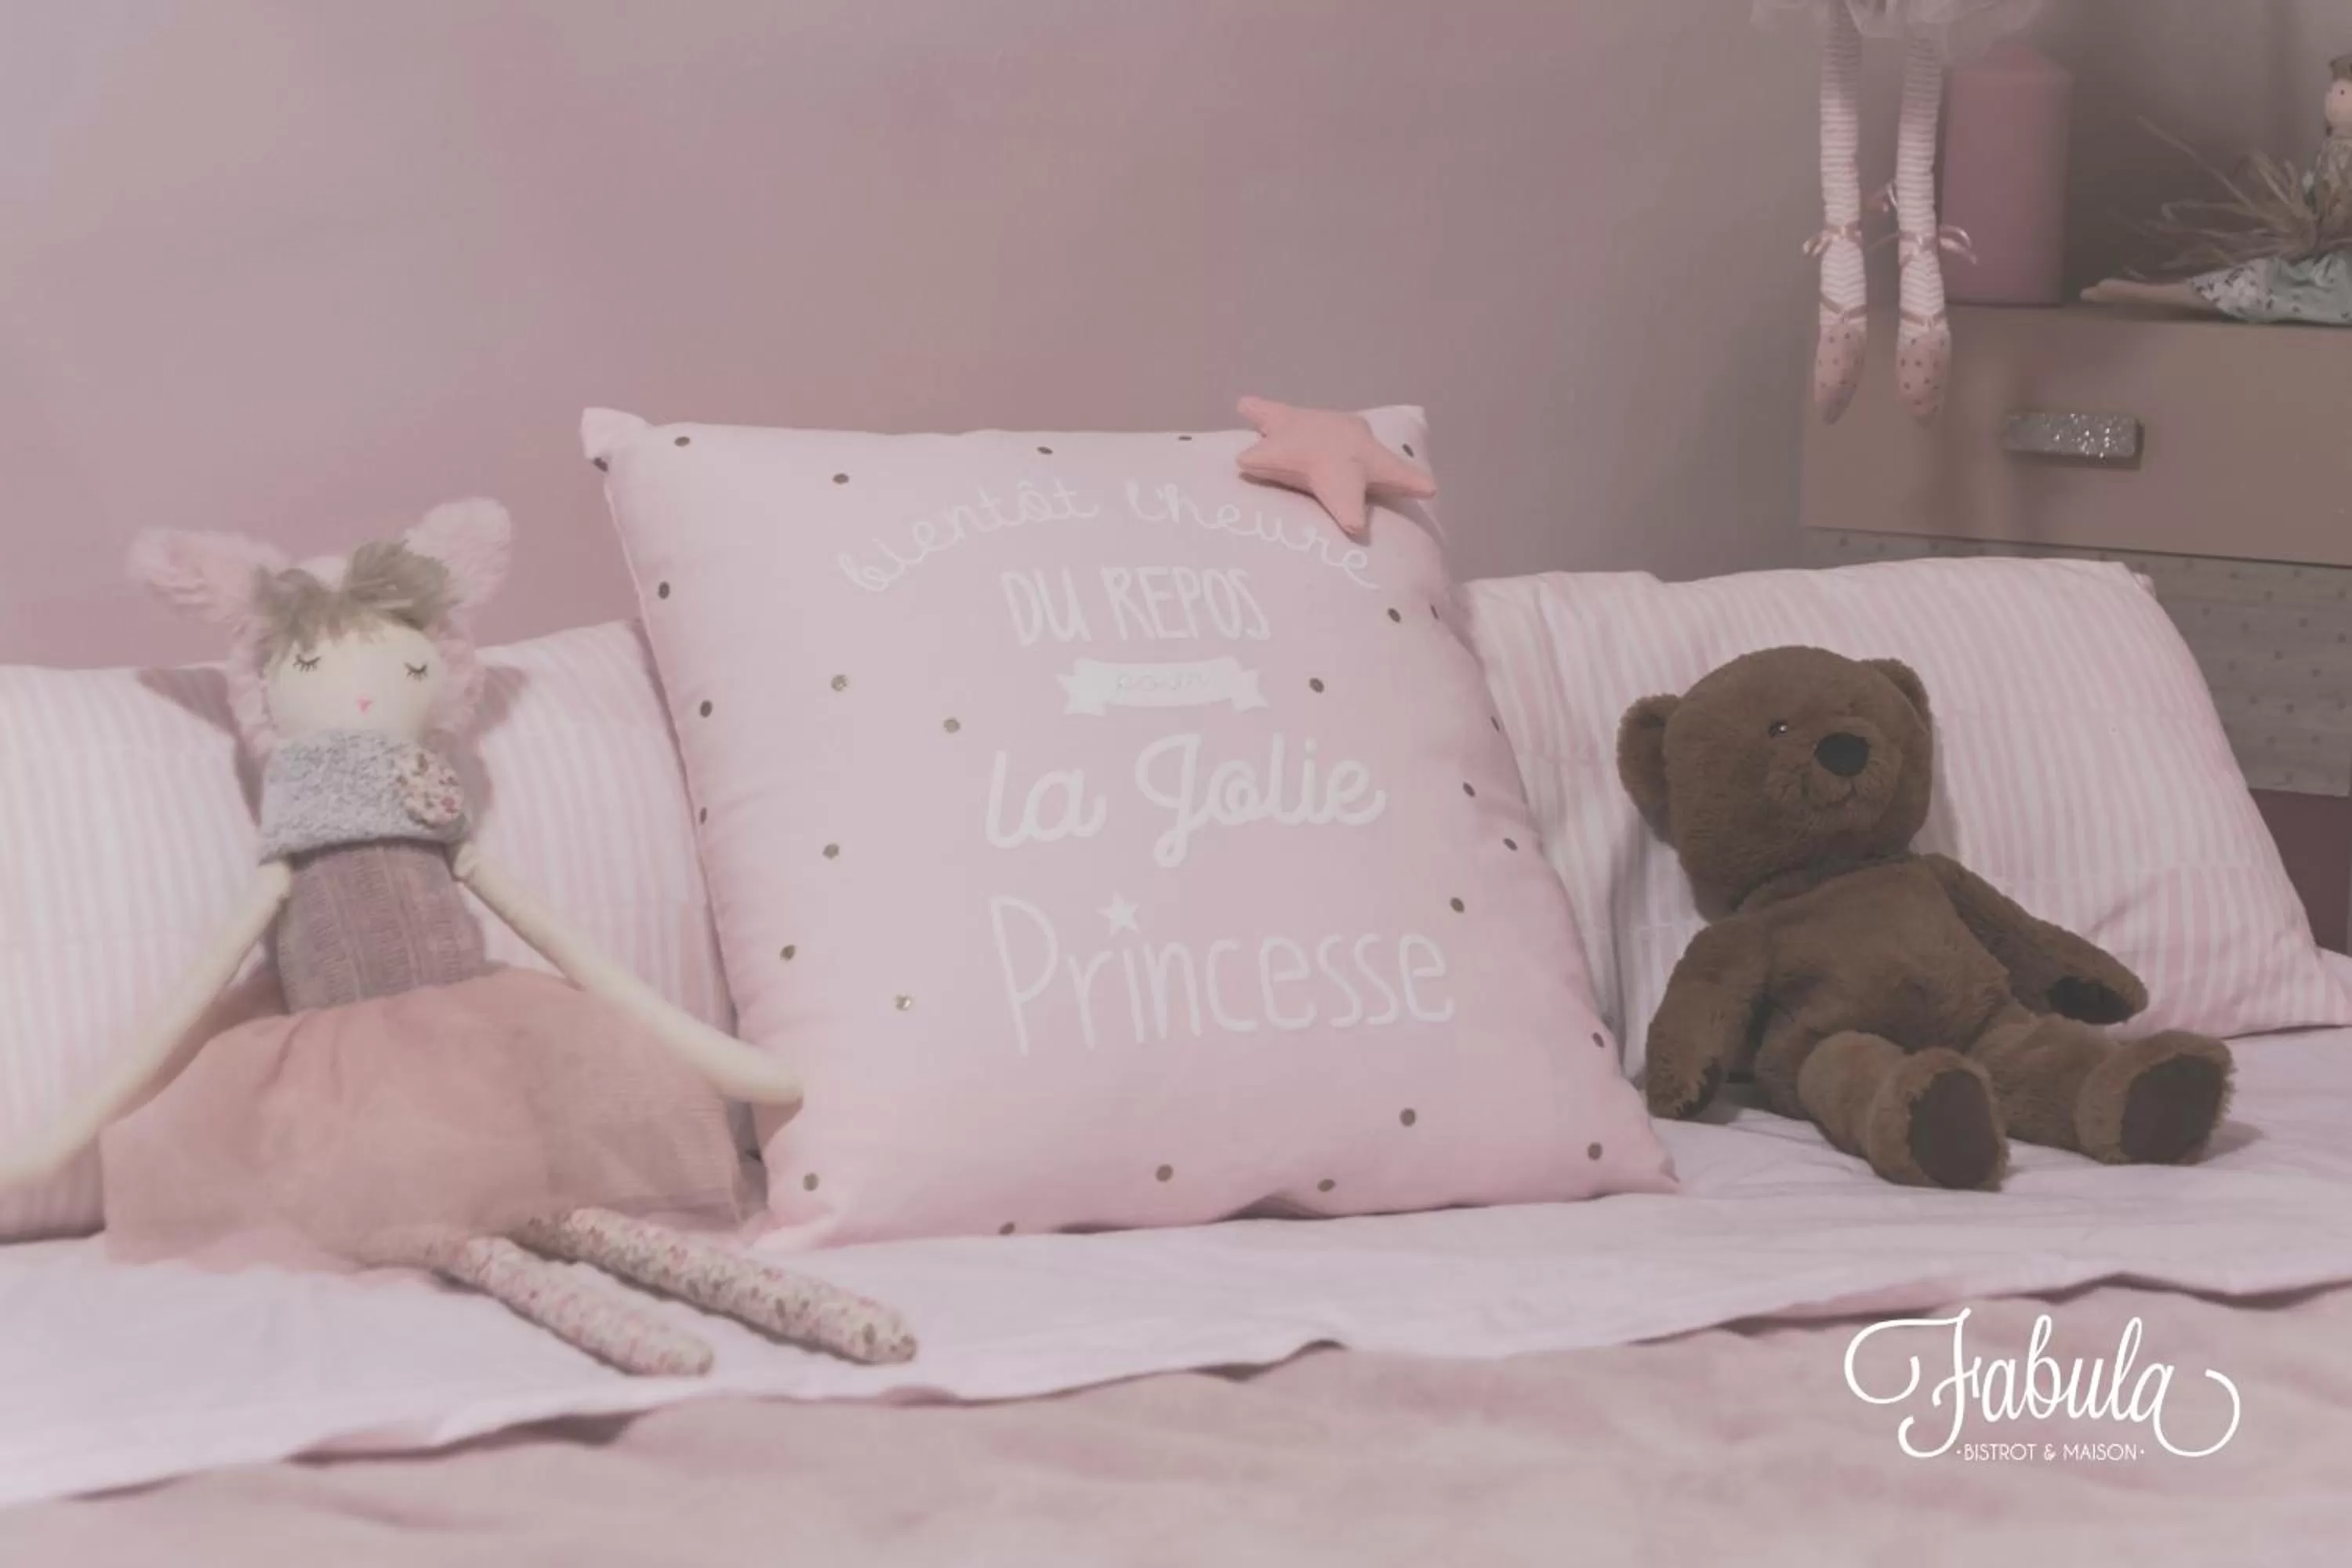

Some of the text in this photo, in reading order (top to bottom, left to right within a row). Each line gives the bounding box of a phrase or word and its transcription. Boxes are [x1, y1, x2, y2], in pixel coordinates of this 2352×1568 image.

[837, 477, 1381, 593] bientôt l'heure
[1000, 565, 1271, 648] DU REPOS
[1134, 731, 1388, 868] Jolie
[989, 891, 1456, 1058] Princesse
